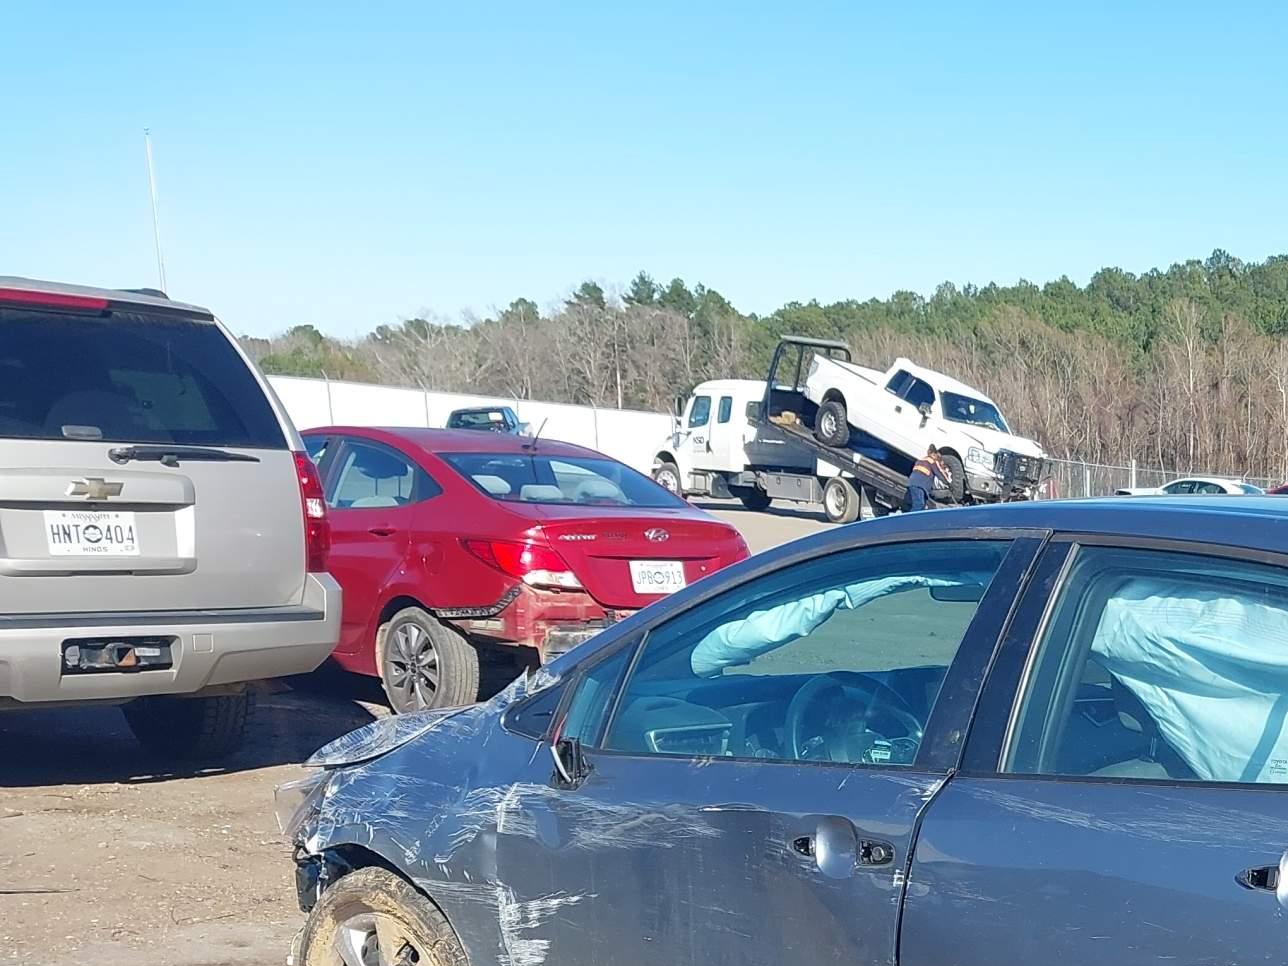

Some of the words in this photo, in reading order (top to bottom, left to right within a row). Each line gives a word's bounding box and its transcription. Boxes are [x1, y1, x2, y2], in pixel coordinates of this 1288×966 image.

[50, 524, 81, 544] HNT
[105, 524, 135, 544] 404
[636, 570, 653, 584] JPB
[665, 571, 683, 585] 913
